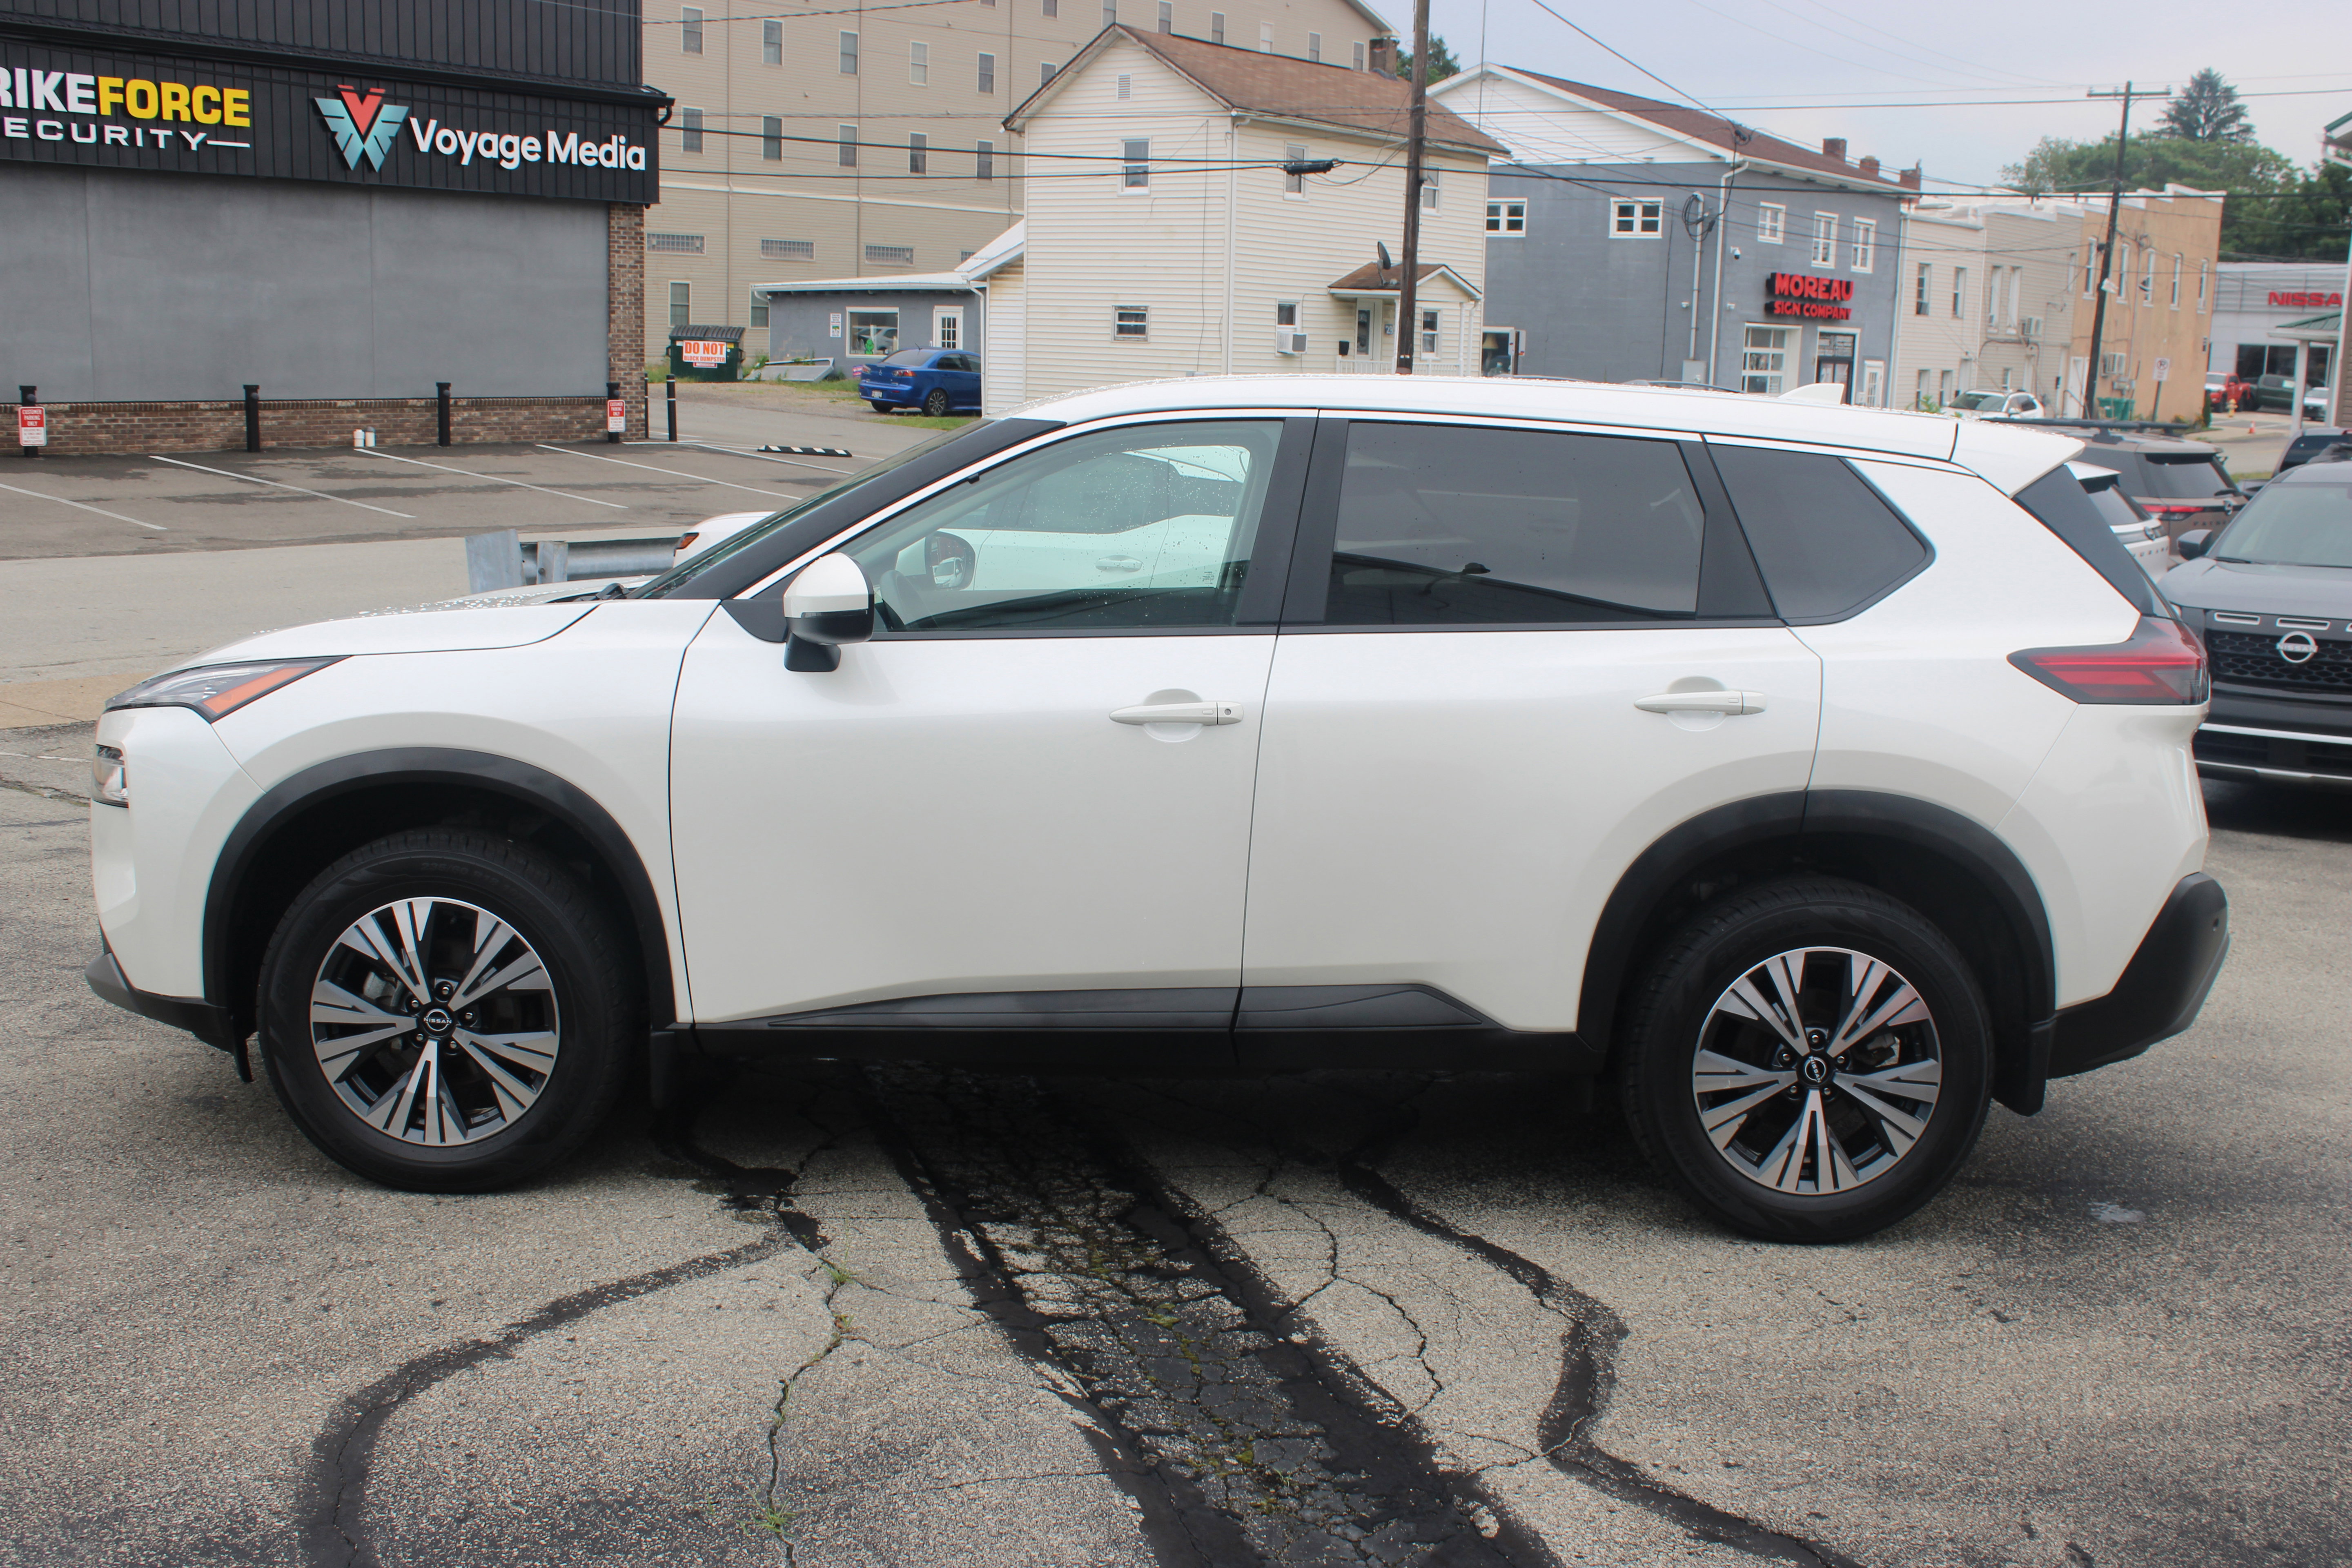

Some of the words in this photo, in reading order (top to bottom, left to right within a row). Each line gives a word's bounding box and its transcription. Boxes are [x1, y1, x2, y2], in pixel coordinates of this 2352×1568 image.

[410, 117, 541, 170] Voyage
[547, 130, 646, 171] Media
[1775, 272, 1854, 301] MOREAU
[1774, 300, 1801, 316] SIGN
[1803, 303, 1853, 320] COMPANY
[685, 342, 700, 354] DO
[703, 343, 725, 355] NOT
[2278, 643, 2317, 653] NISSAN
[1809, 1056, 1823, 1083] NISSAN
